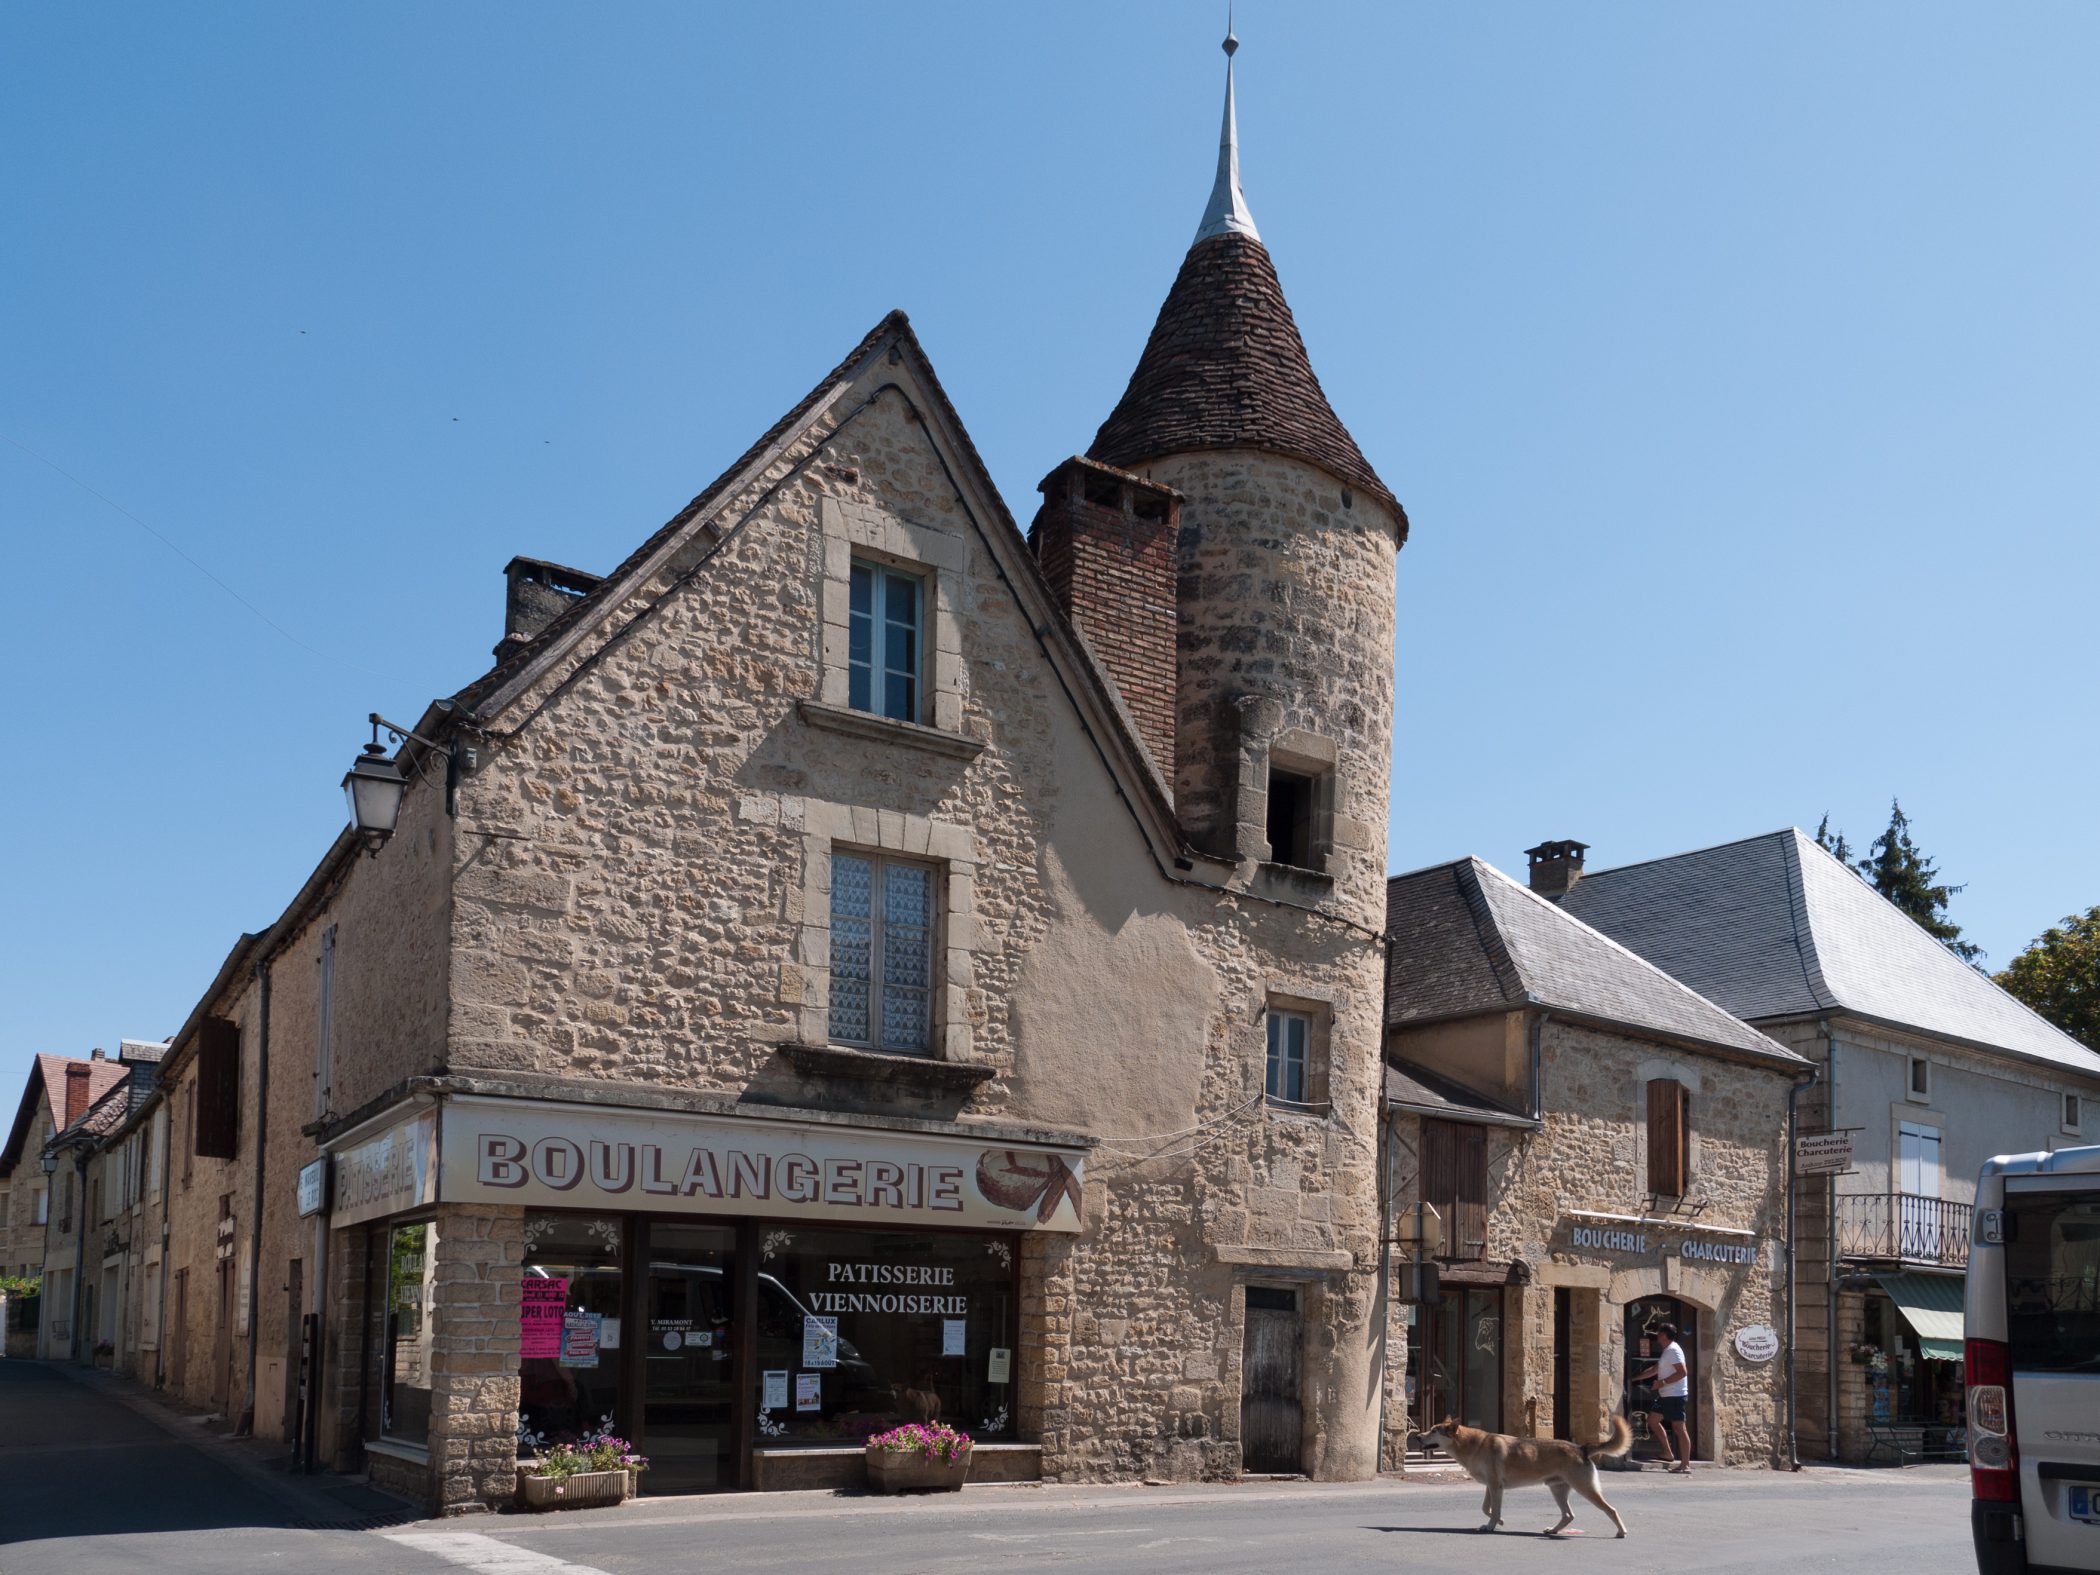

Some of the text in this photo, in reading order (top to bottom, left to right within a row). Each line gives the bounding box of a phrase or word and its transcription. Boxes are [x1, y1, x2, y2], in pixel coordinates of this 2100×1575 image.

[1801, 1137, 1848, 1148] Boucherie
[1797, 1146, 1852, 1157] Charcuterie
[338, 1139, 415, 1211] PATISSERIE
[477, 1134, 963, 1211] BOULANGERIE
[1573, 1227, 1646, 1254] BOUCHERIE
[1681, 1240, 1757, 1265] CHARCUTERIE
[828, 1263, 954, 1286] PATISSERIE
[521, 1280, 562, 1289] CARSAC
[809, 1292, 967, 1314] VIENNOISERIE
[544, 1306, 564, 1318] LOTO
[1740, 1348, 1774, 1360] Charcuterie
